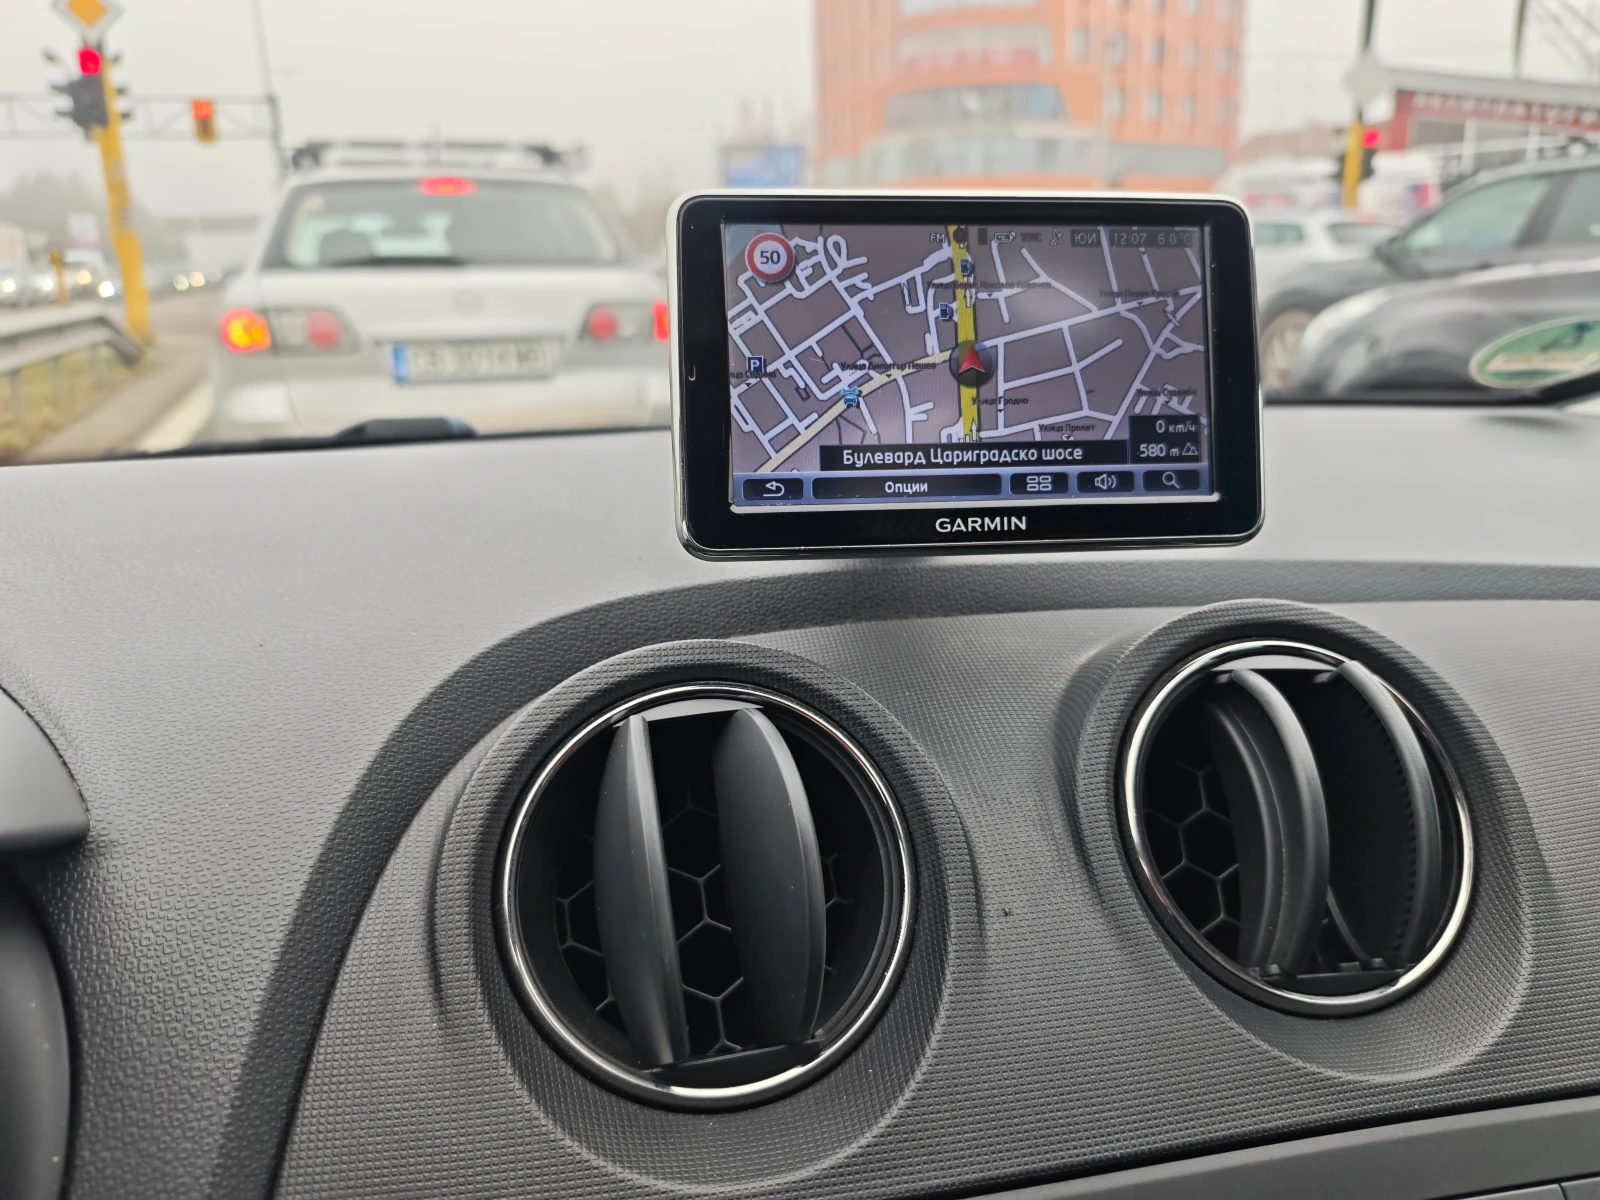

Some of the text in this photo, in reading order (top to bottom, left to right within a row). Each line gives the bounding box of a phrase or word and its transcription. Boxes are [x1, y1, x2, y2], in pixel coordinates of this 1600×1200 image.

[930, 234, 945, 243] FM
[1074, 233, 1097, 244] ЮИ
[1113, 233, 1146, 245] 12:07
[760, 250, 780, 265] 50
[750, 359, 760, 372] P
[841, 361, 937, 371] Улица Димитър Пешев
[971, 396, 1029, 405] Улица Гродно
[1039, 423, 1096, 432] Улица Пролет
[1156, 420, 1165, 433] 0
[843, 446, 1083, 467] Булевард Цариградско шосе
[1140, 443, 1166, 457] 580
[885, 481, 928, 494] Опции
[935, 516, 1027, 533] GARMIN
